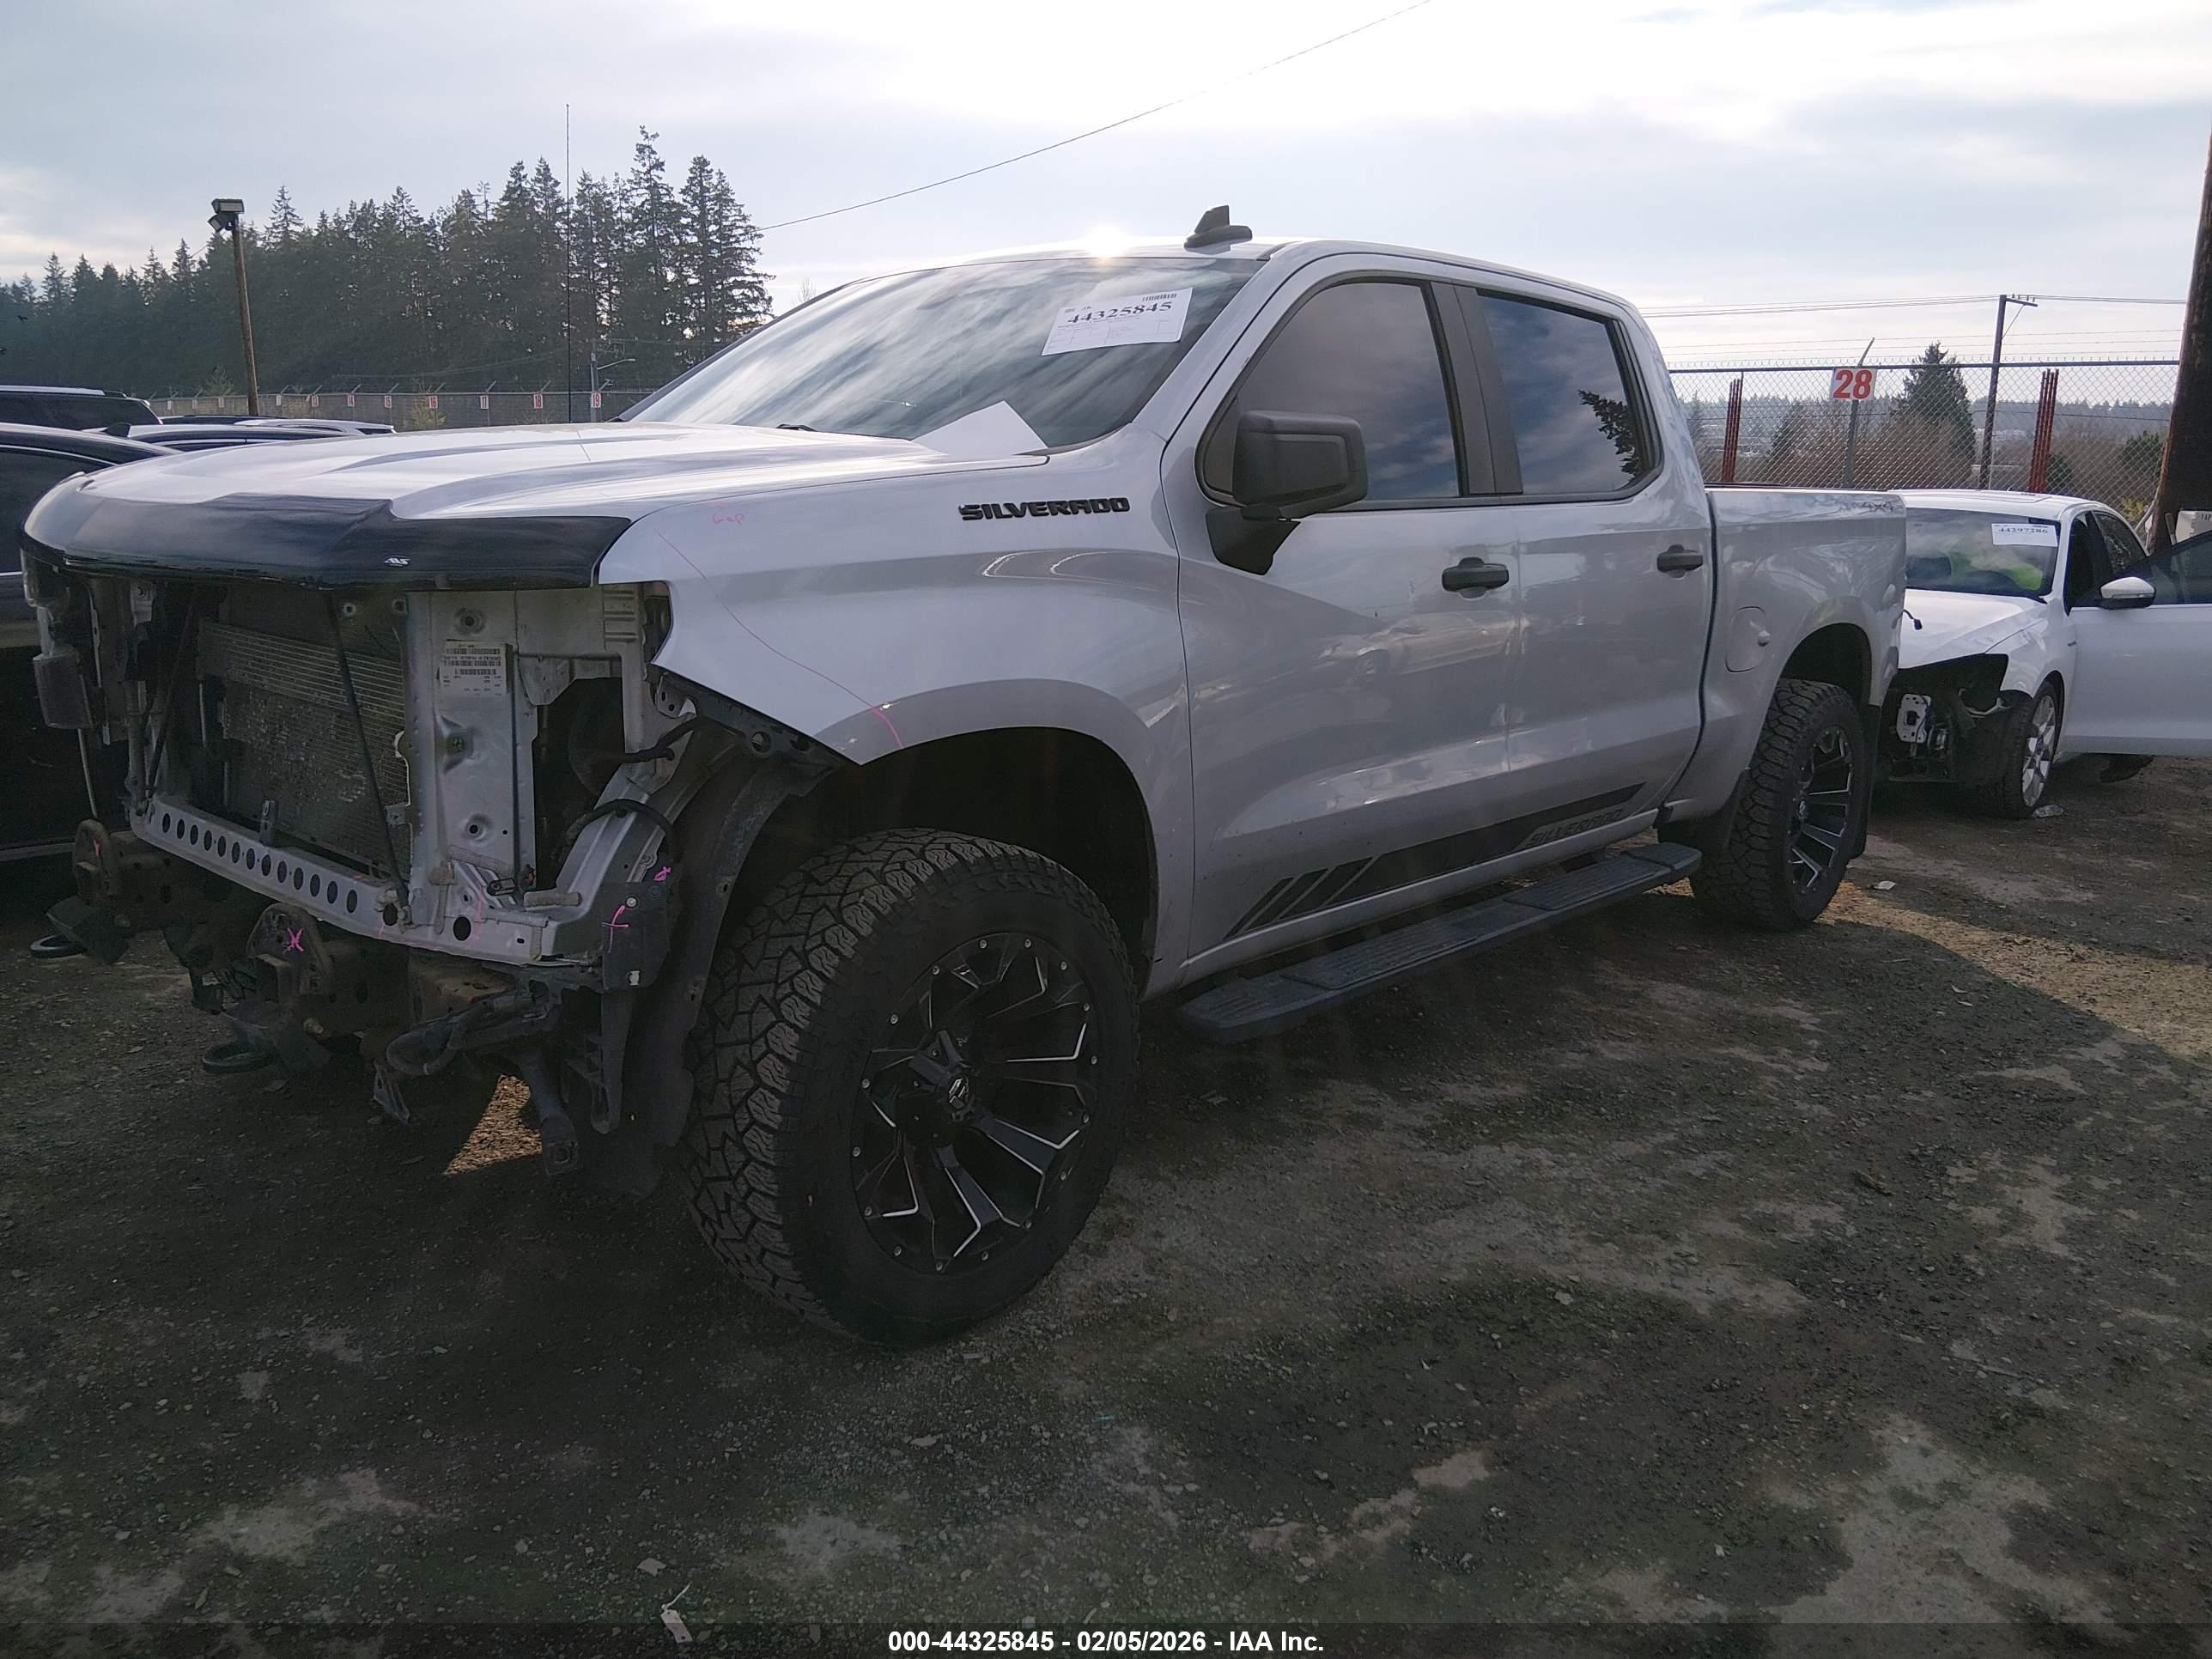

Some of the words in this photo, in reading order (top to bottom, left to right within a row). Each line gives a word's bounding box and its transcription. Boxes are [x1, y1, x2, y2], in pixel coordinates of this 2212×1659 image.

[1067, 301, 1173, 324] 44325845
[1832, 369, 1873, 399] 28
[959, 497, 1131, 520] SILVERADO
